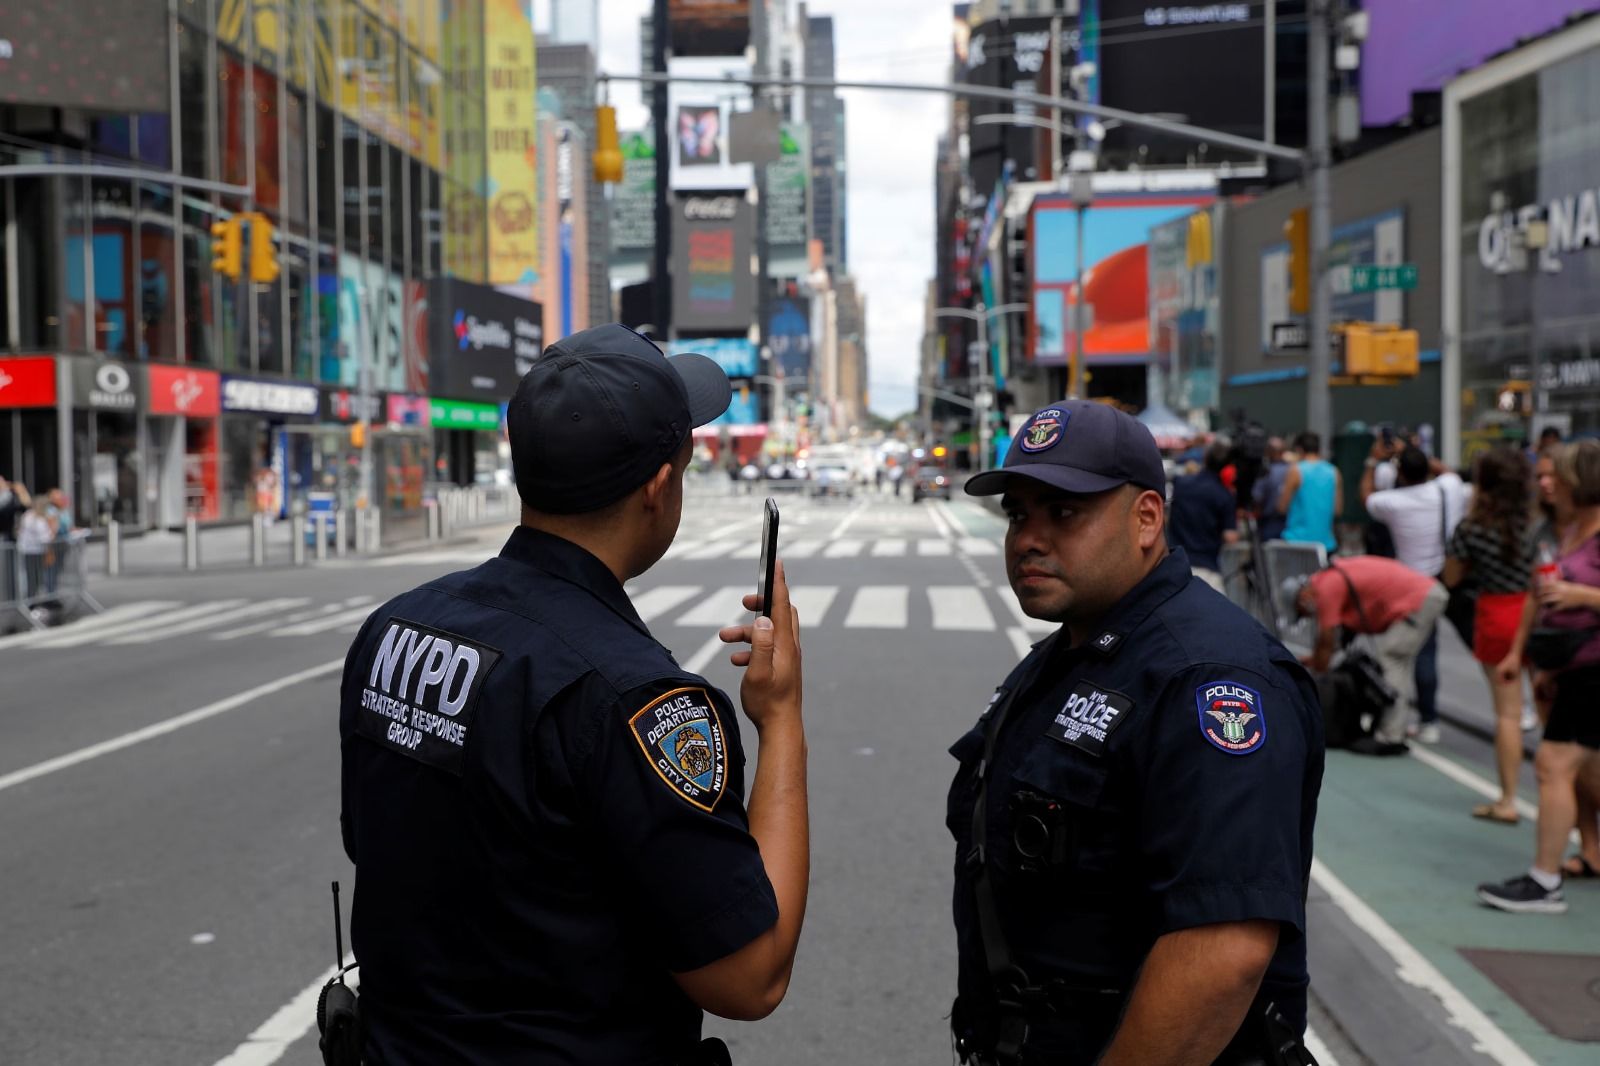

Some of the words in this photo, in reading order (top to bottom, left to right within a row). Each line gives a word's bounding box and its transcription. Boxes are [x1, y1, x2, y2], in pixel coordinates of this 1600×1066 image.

[1036, 409, 1061, 420] NYPD
[369, 624, 480, 717] NYPD
[654, 695, 693, 721] POLICE
[1061, 693, 1119, 730] POLICE
[1205, 685, 1254, 705] POLICE
[361, 688, 410, 724] STRATEGIC
[411, 707, 467, 746] RESPONSE
[647, 705, 710, 745] DEPARTMENT
[387, 721, 422, 750] GROUP
[712, 724, 723, 760] YORK
[658, 758, 683, 785] CITY
[683, 783, 700, 796] OF
[713, 763, 724, 791] NEW
